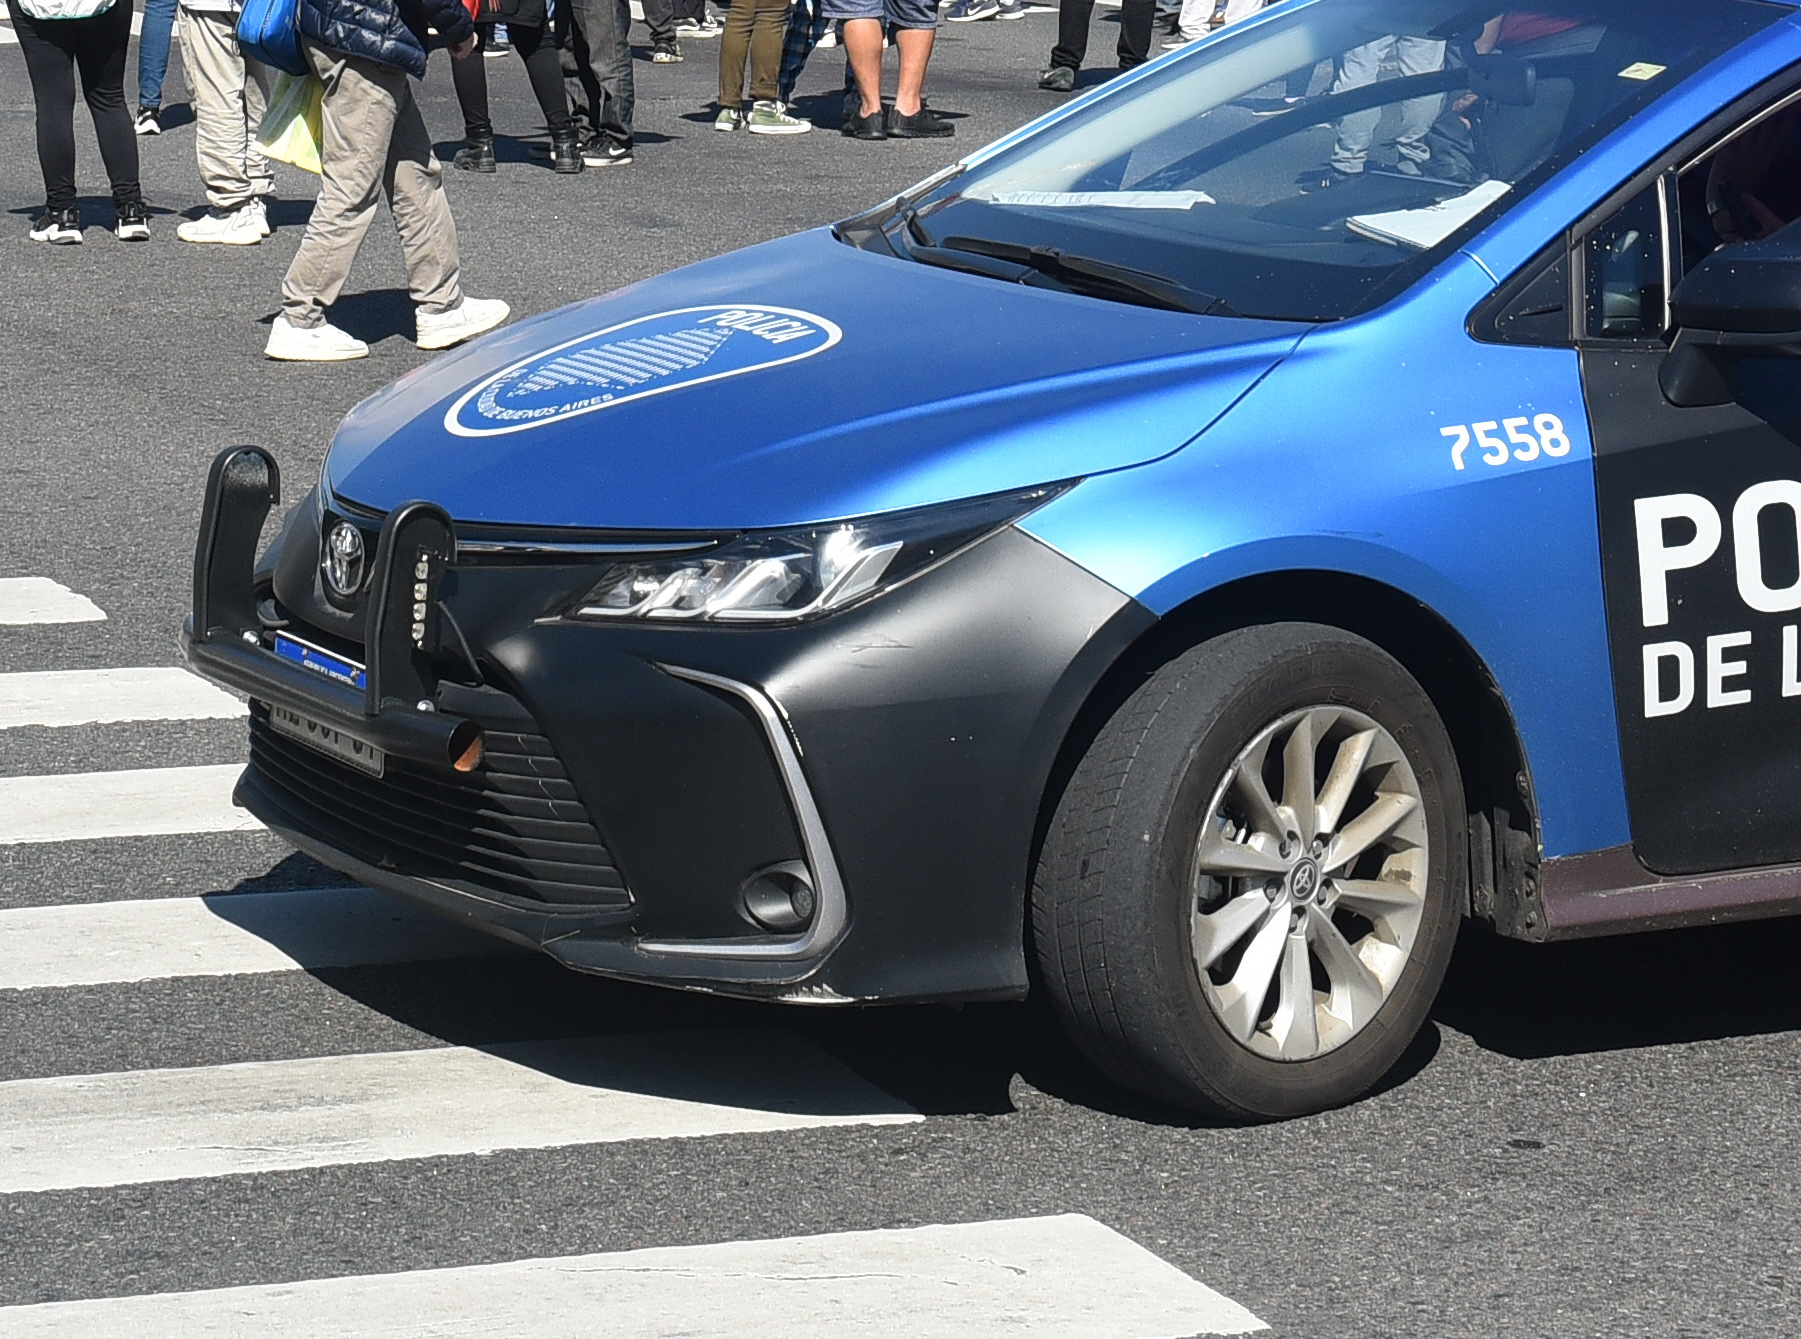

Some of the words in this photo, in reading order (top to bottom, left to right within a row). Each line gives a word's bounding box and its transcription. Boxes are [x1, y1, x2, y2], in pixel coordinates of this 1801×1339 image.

[698, 310, 817, 345] POLICIA
[559, 393, 614, 413] AIRES
[1440, 412, 1571, 471] 7558
[1642, 631, 1752, 719] DE
